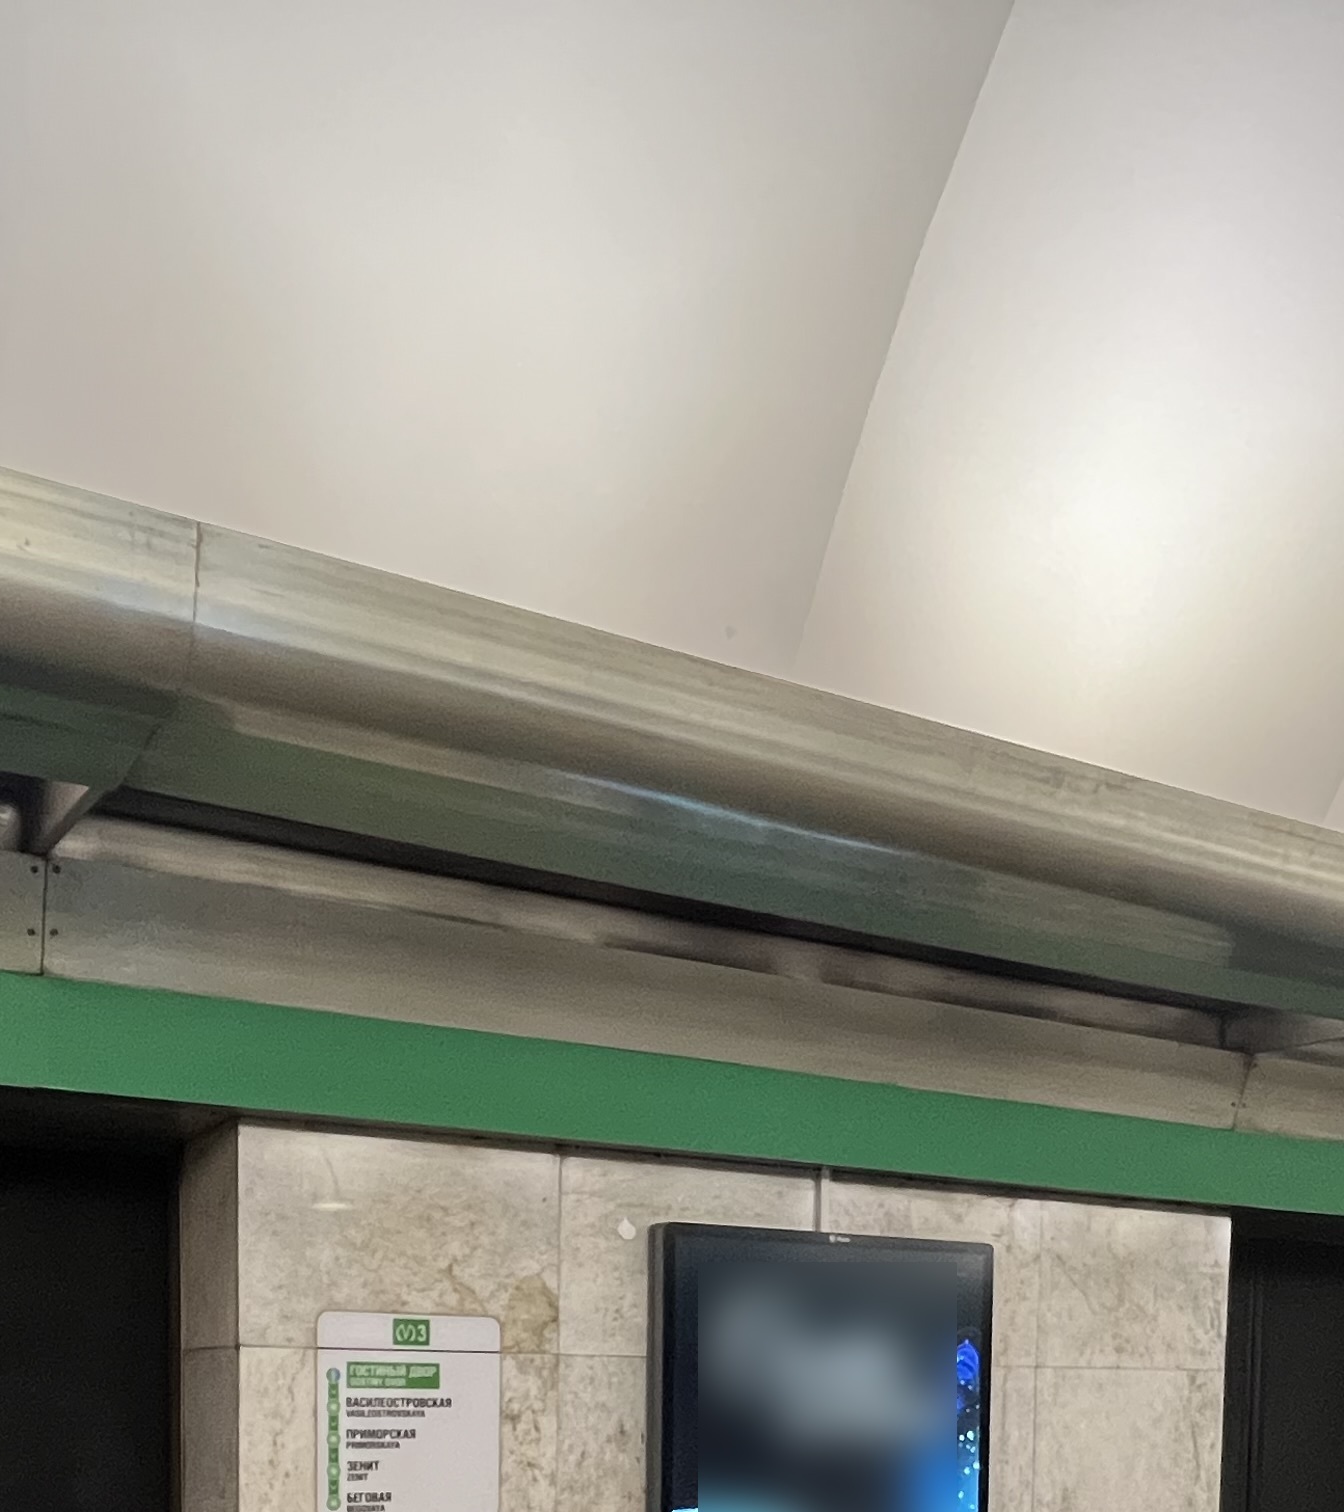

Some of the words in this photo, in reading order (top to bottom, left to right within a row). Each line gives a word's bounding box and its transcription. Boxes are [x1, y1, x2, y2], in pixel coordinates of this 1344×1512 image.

[346, 1397, 452, 1408] ВАСИЛЕОСТРОВСКАЯ
[346, 1428, 416, 1439] ПРИМОРСКАЯ
[347, 1460, 380, 1472] ЗЕНИТ
[347, 1491, 392, 1503] БЕГОВАЯ
